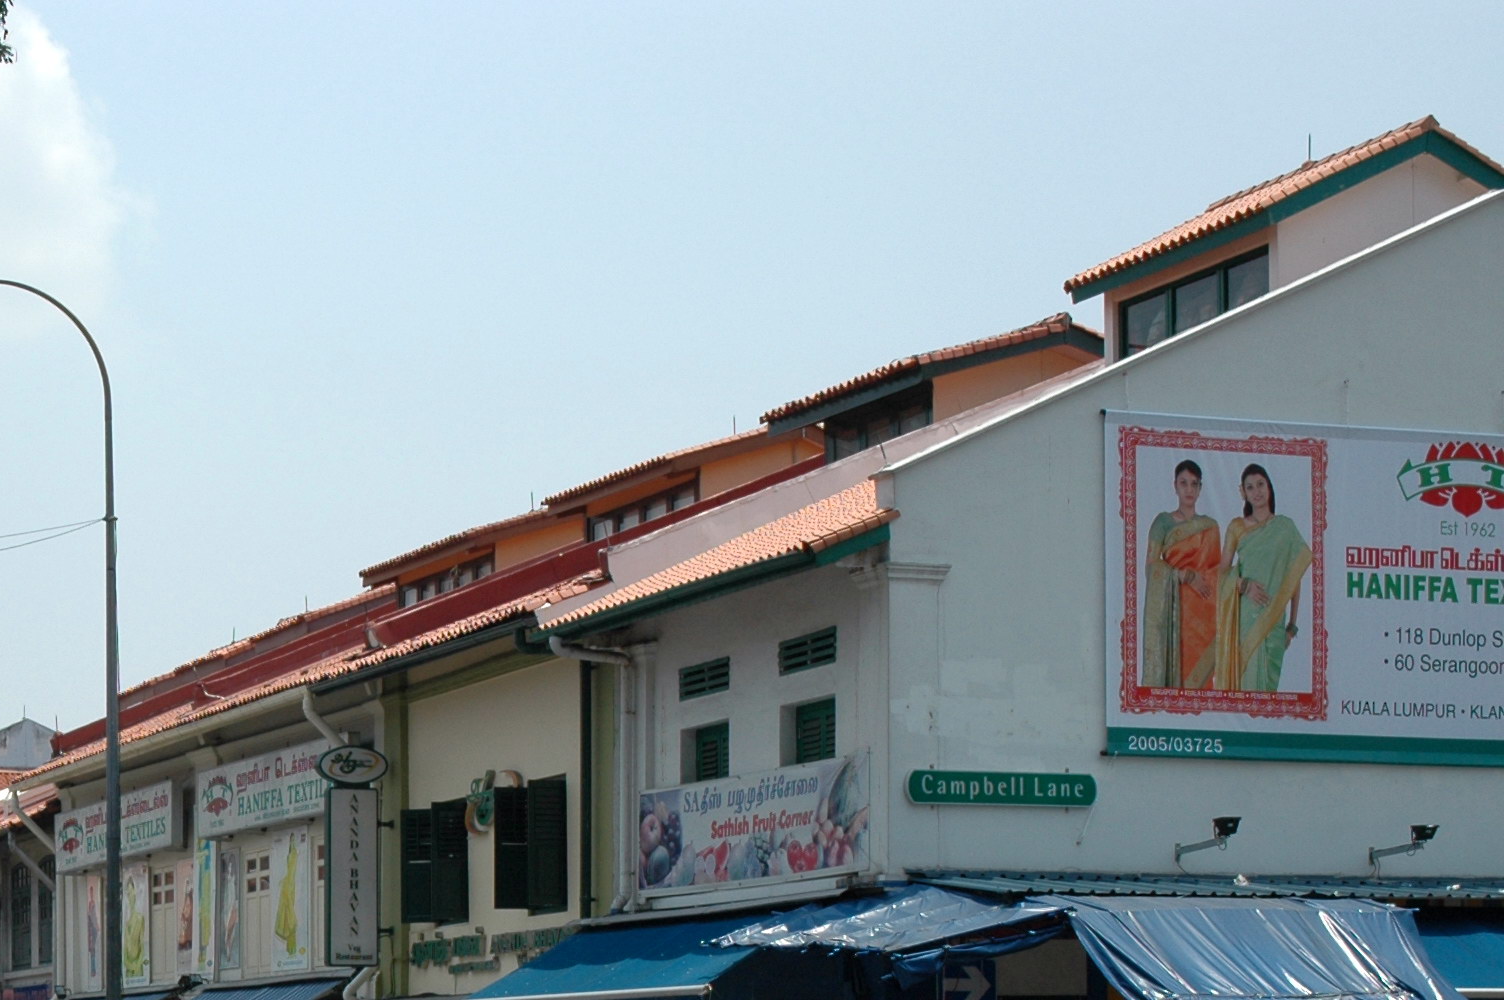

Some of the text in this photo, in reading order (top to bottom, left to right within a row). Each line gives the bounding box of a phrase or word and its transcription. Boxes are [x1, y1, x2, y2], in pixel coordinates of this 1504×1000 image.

[1440, 520, 1496, 538] Est 1962
[1346, 572, 1458, 604] HANIFFA
[1396, 627, 1424, 645] 118
[1429, 628, 1487, 651] Dunlop
[1394, 654, 1415, 671] 60
[1341, 700, 1390, 716] KUALA
[1394, 702, 1456, 719] LUMPUR
[1128, 735, 1223, 753] 2005/03725
[921, 774, 1084, 800] Campbell Lane
[237, 788, 284, 816] HANIFFA
[125, 816, 166, 844] TEXTILES
[711, 809, 814, 840] Sathish Fruit Corner
[349, 793, 360, 937] ANANDA BHAVAN
[335, 951, 373, 961] Restaurant
